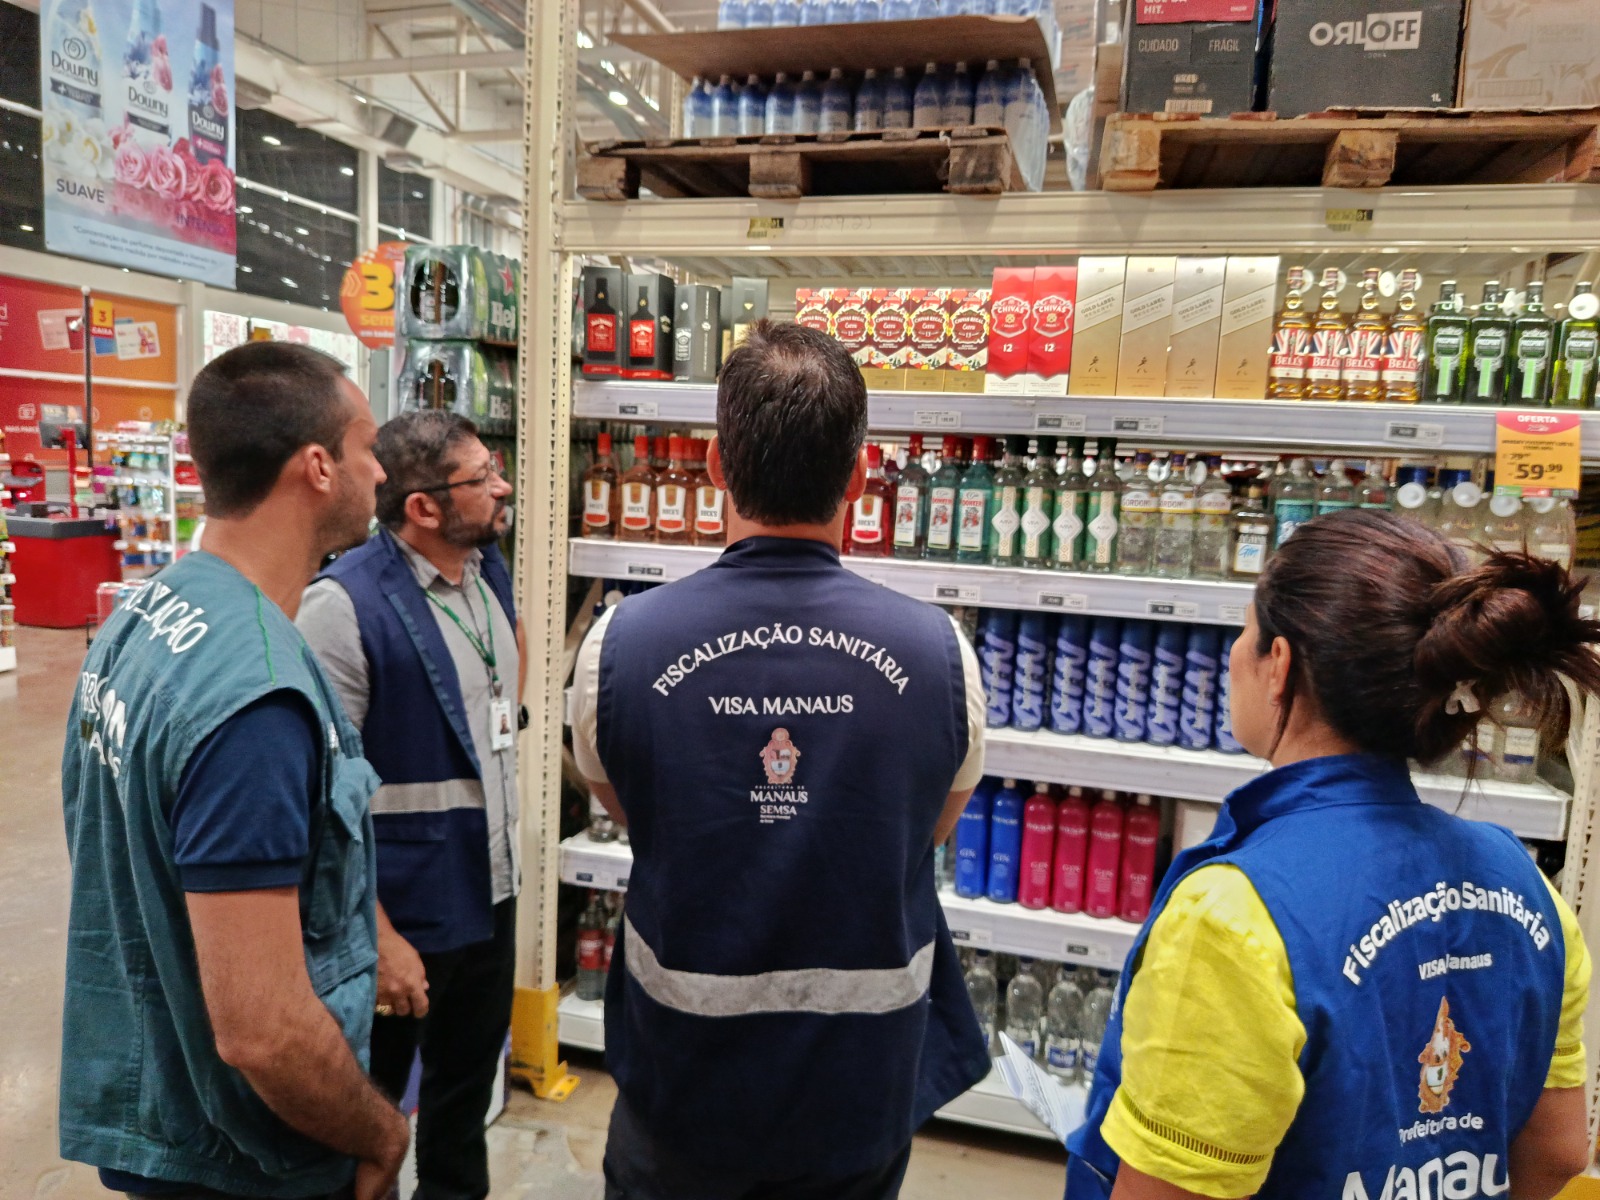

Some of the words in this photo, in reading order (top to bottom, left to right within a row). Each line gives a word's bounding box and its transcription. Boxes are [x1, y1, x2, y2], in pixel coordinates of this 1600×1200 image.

[1144, 4, 1164, 15] HIT.
[1309, 16, 1419, 47] ORLOFF
[1138, 38, 1179, 53] CUIDADO
[1208, 37, 1240, 52] FRÁGIL
[51, 50, 99, 87] Downy
[128, 86, 169, 118] Downy
[192, 111, 225, 141] Downy
[56, 177, 105, 203] SUAVE
[361, 262, 395, 311] 3
[98, 309, 107, 323] 3
[997, 305, 1025, 314] CHIVAS
[1038, 305, 1066, 313] CHIVAS
[1002, 343, 1013, 353] 12
[1044, 343, 1055, 352] 12
[1517, 414, 1559, 423] OFERTA
[652, 623, 803, 697] FISCALIZAÇÃO
[808, 626, 909, 695] SANITÁRIA
[708, 695, 759, 715] VISA
[763, 694, 854, 715] MANAUS
[750, 790, 808, 804] MANAUS
[760, 804, 797, 816] SEMSA
[1342, 881, 1461, 986] Fiscalização
[1461, 881, 1550, 951] Sanitária
[1418, 957, 1447, 980] VISA
[1459, 1112, 1484, 1130] de
[1341, 1150, 1510, 1200] Manau
